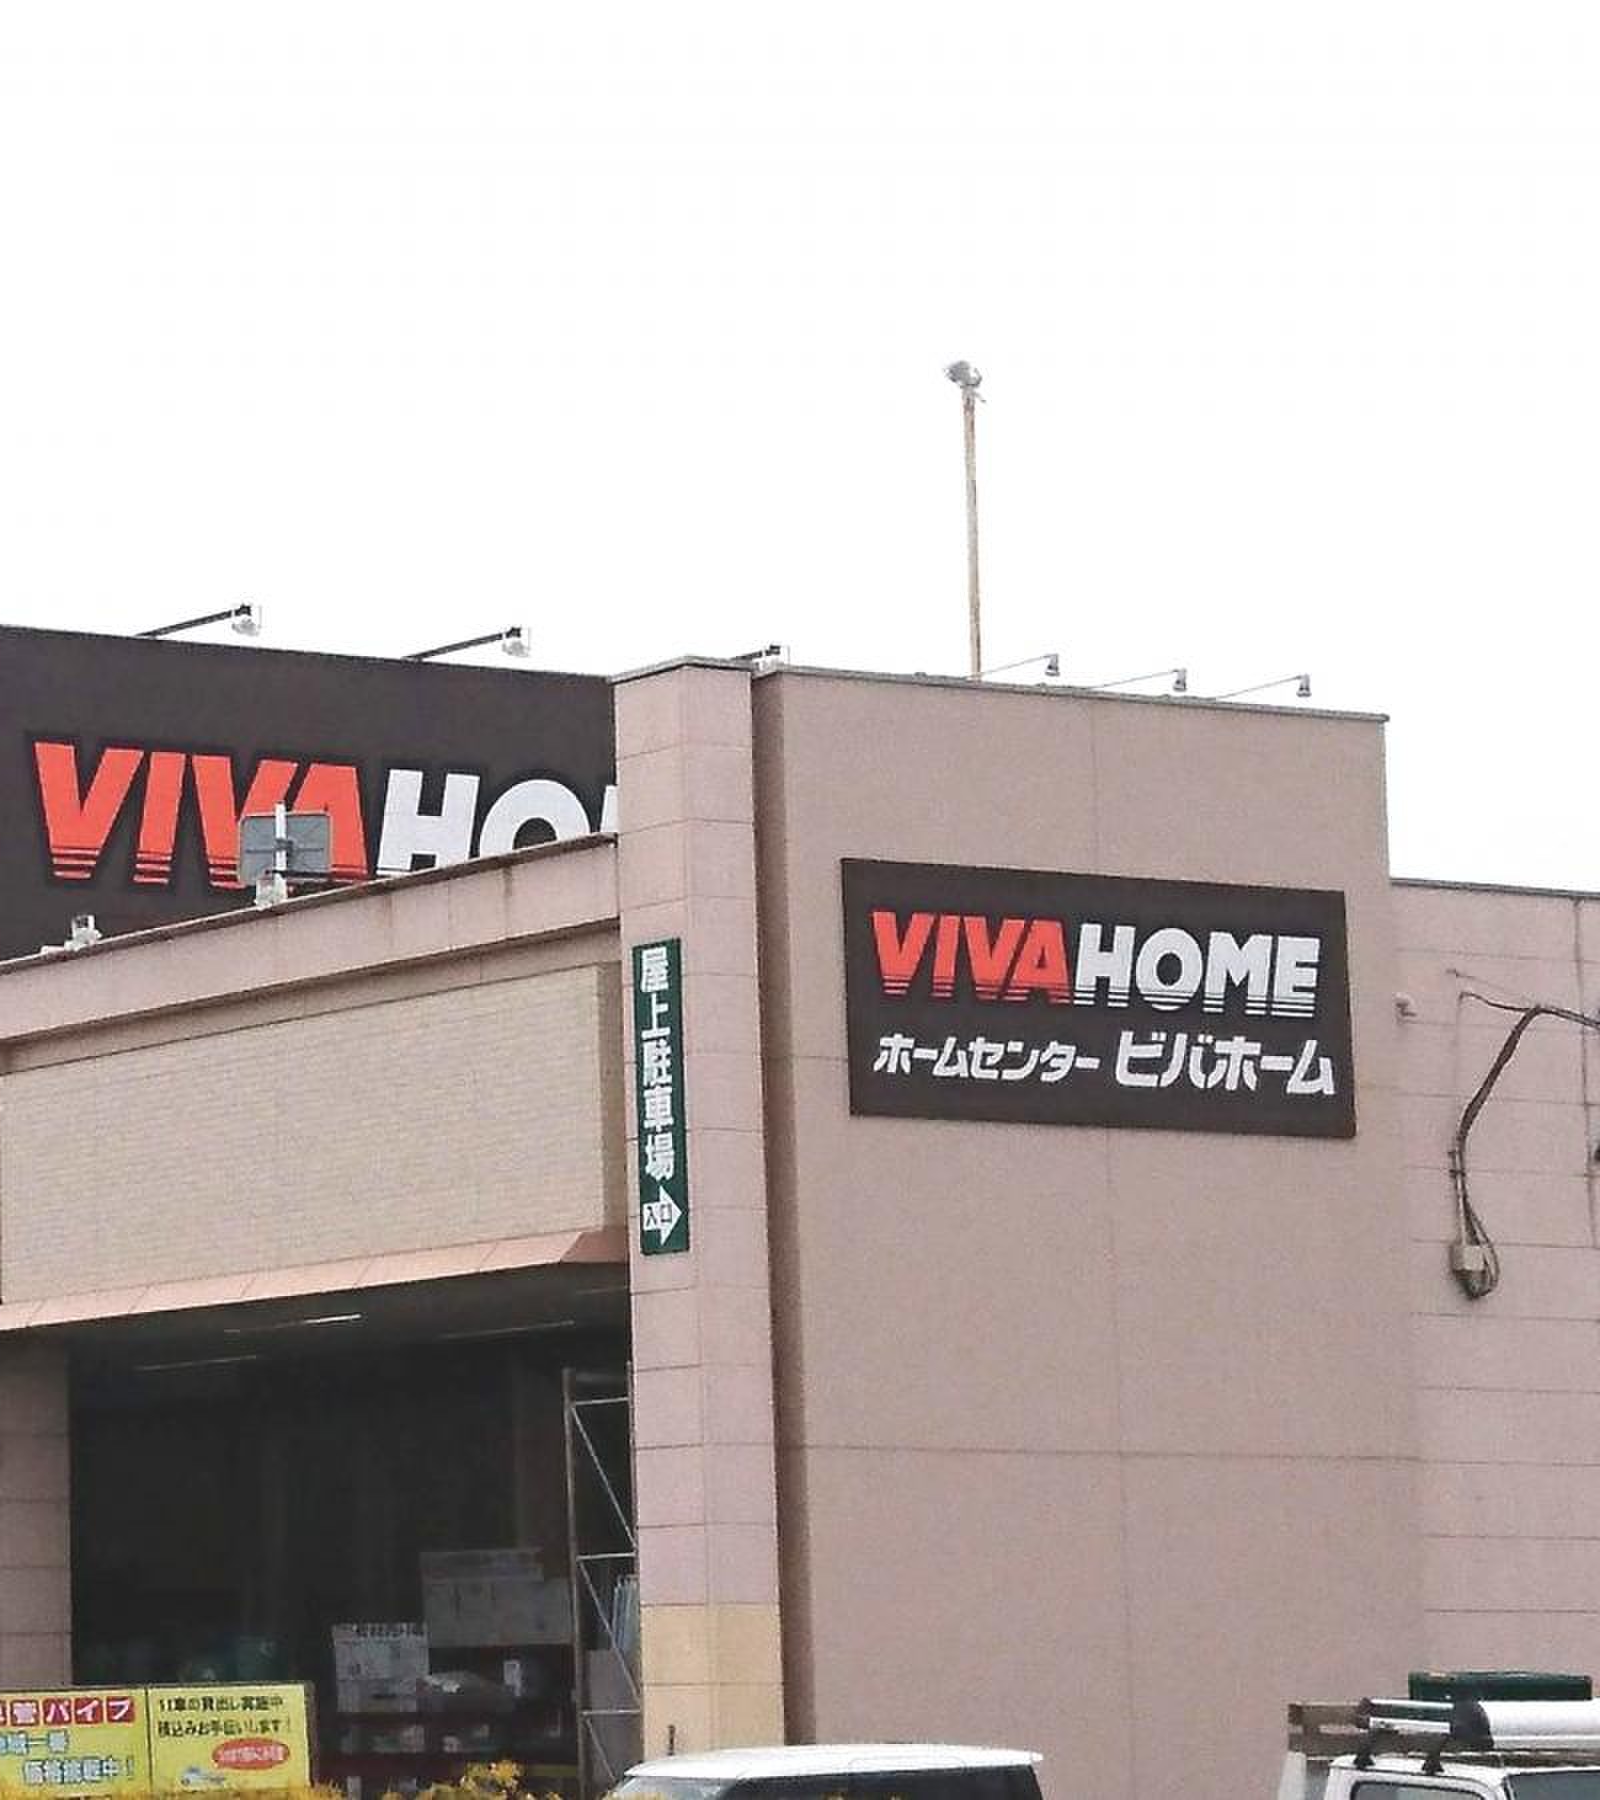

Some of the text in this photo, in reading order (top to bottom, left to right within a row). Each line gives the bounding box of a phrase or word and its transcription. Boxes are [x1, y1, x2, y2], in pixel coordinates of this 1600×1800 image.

[873, 911, 1320, 1018] VIVAHOME
[640, 946, 675, 1181] 屋上駐車場
[873, 1031, 1336, 1095] ホームセンター ビバホーム
[645, 1202, 673, 1226] 入口
